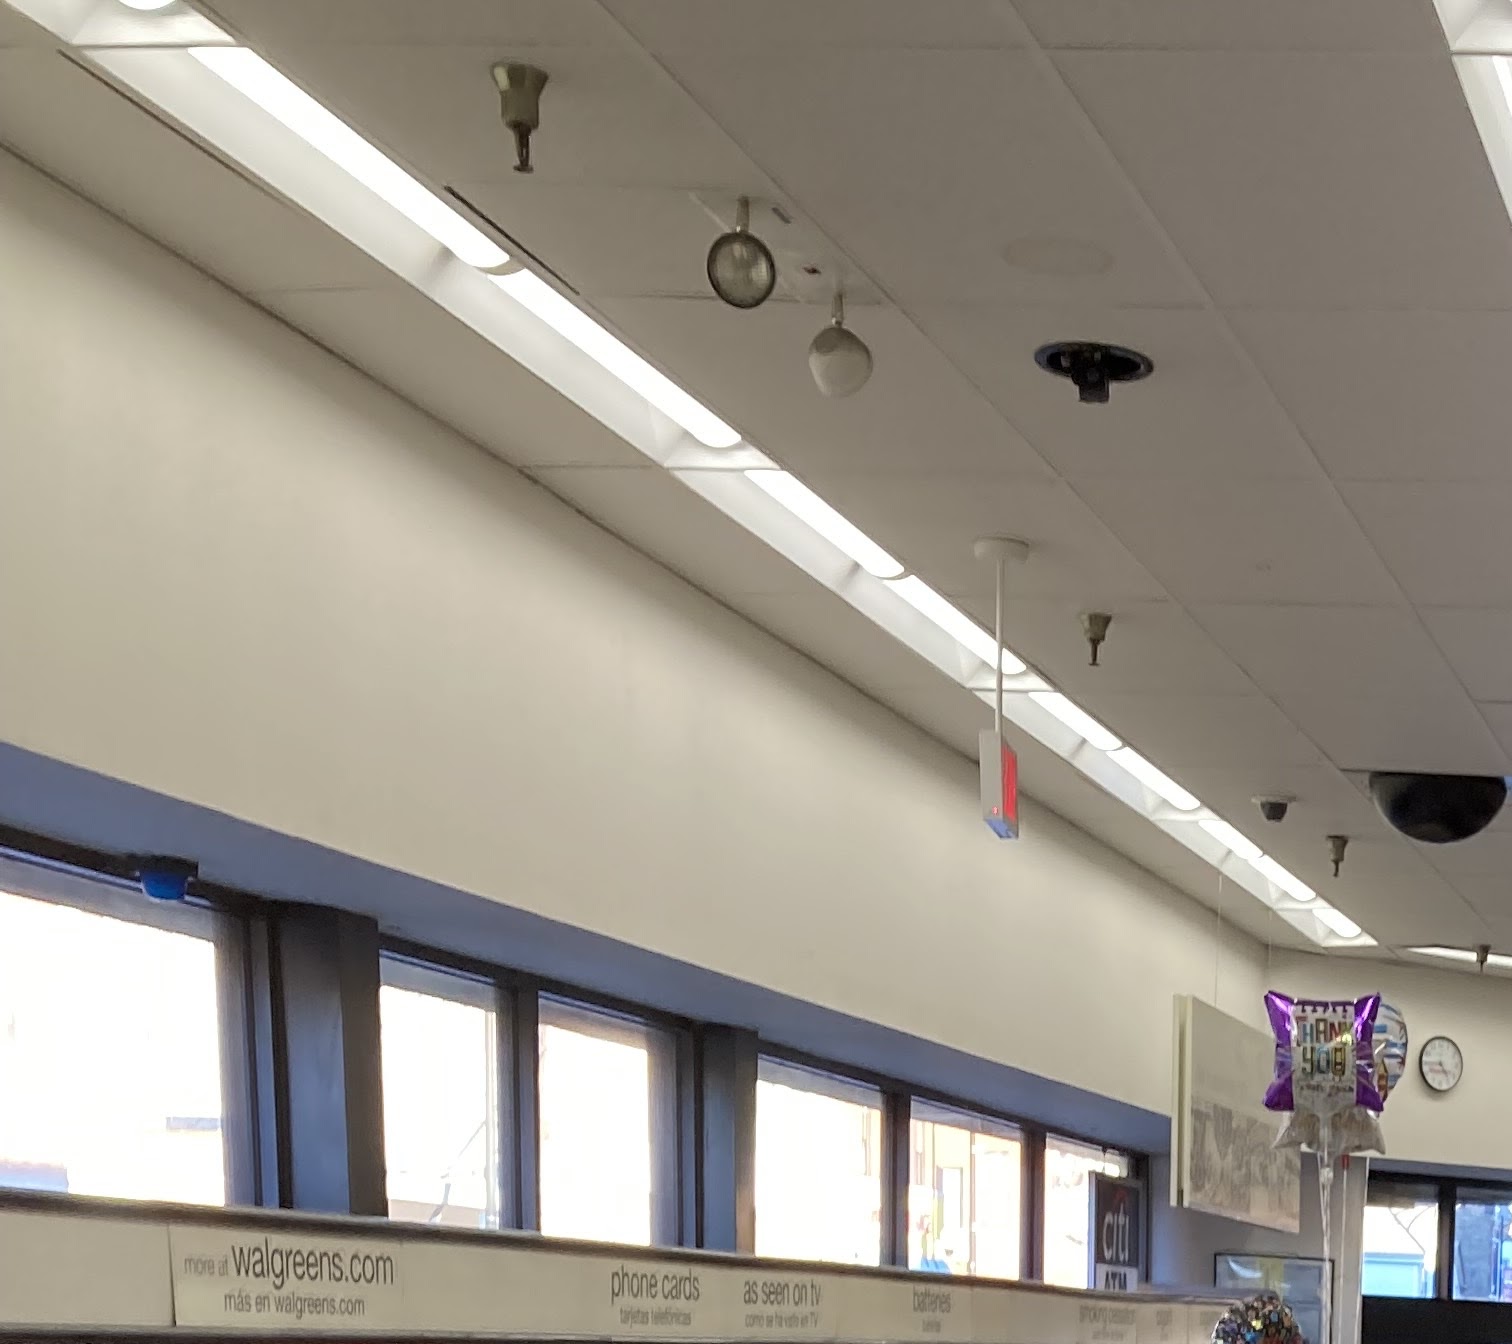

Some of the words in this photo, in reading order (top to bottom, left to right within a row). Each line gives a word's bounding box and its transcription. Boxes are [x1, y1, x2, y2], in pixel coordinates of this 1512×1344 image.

[1295, 1015, 1354, 1047] THANK
[1302, 1046, 1346, 1078] YOU
[1103, 1204, 1130, 1262] citi
[231, 1236, 394, 1290] walgreens.com
[611, 1264, 657, 1305] phone
[662, 1268, 700, 1301] cards
[743, 1280, 758, 1305] as
[761, 1281, 789, 1306] seen
[792, 1283, 807, 1307] on
[810, 1279, 822, 1307] tv
[912, 1286, 951, 1314] batteries
[224, 1288, 251, 1312] más
[255, 1293, 270, 1312] en
[274, 1293, 365, 1320] walgreens.com
